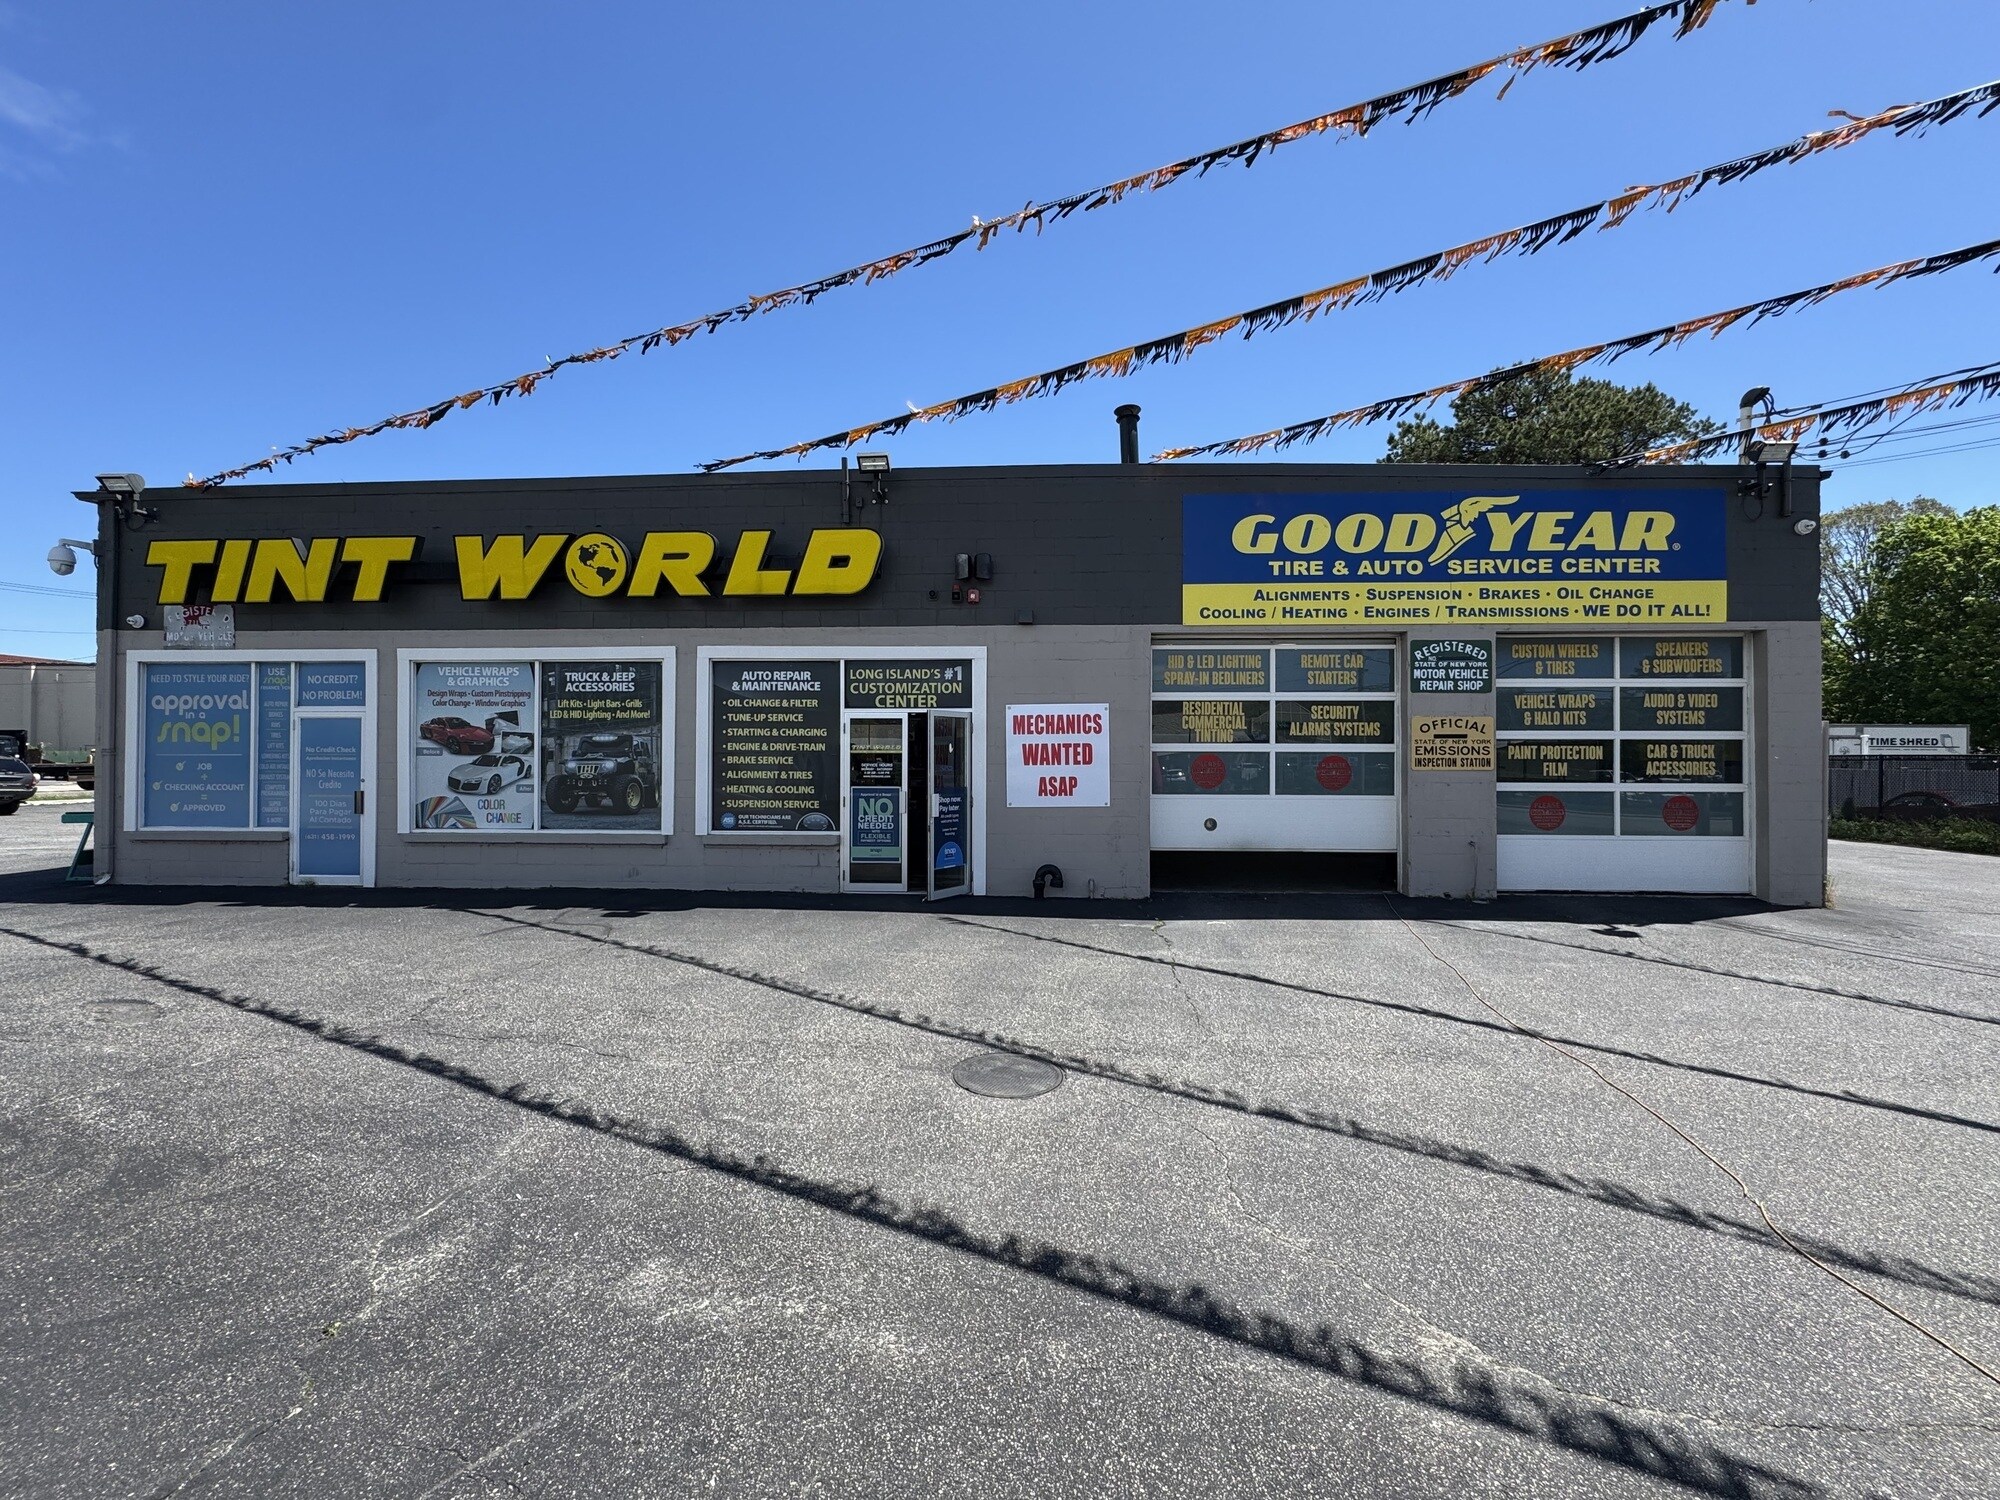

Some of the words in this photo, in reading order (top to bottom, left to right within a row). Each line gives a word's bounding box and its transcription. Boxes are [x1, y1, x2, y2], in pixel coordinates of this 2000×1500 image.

[1232, 513, 1437, 554] GOOD
[1486, 511, 1676, 551] YEAR
[146, 536, 419, 604] TINT
[453, 528, 884, 600] WORLD
[1268, 561, 1324, 575] TIRE
[1332, 560, 1350, 575] &
[1357, 559, 1424, 575] AUTO
[1447, 558, 1553, 574] SERVICE
[1560, 558, 1661, 573] CENTER
[1199, 607, 1267, 619] COOLING
[1282, 606, 1348, 619] HEATING
[1364, 606, 1430, 618] ENGINES
[1445, 605, 1570, 617] TRANSMISSIONS
[1583, 605, 1610, 617] WE
[1616, 605, 1642, 617] DO
[1648, 605, 1666, 617] IT
[1671, 604, 1711, 617] ALL!
[1414, 641, 1488, 660] REGISTERED
[1512, 644, 1554, 658] CUSTOM
[1558, 644, 1599, 658] WHEELS
[1655, 642, 1709, 656] SPEAKERS
[1168, 655, 1184, 669] HID
[1187, 655, 1195, 669] &
[1197, 655, 1214, 669] LED
[1217, 655, 1262, 669] LIGHTING
[1301, 655, 1341, 668] REMOTE
[1343, 655, 1364, 668] CAR
[1535, 661, 1543, 675] &
[1546, 661, 1575, 675] TIRES
[1642, 659, 1650, 673] &
[1653, 659, 1723, 673] SUBWOOFERS
[437, 666, 480, 676] VEHICLE
[482, 666, 519, 676] WRAPS
[565, 672, 600, 682] TRUCK
[601, 672, 610, 682] &
[611, 672, 636, 682] JEEP
[742, 671, 772, 681] AUTO
[773, 671, 812, 681] REPAIR
[850, 669, 883, 679] LONG
[944, 666, 963, 681] #1
[1164, 671, 1210, 685] SPRAY-IN
[1212, 671, 1265, 685] BEDLINERS
[1307, 671, 1357, 685] STARTERS
[1414, 669, 1446, 679] MOTOR
[1448, 669, 1489, 679] VEHICLE
[150, 674, 171, 683] NEED
[173, 674, 182, 683] TO
[184, 674, 205, 683] STYLE
[207, 674, 228, 683] YOUR
[229, 674, 250, 683] RIDE?
[308, 675, 321, 684] NO
[323, 675, 358, 684] CREDIT?
[447, 677, 456, 686] &
[457, 677, 510, 687] GRAPHICS
[565, 682, 635, 692] ACCESSORIES
[732, 682, 741, 691] &
[742, 681, 821, 691] MAINTENANCE
[850, 682, 962, 694] CUSTOMIZATION
[1420, 681, 1454, 691] REPAIR
[1457, 681, 1484, 691] SHOP
[303, 691, 316, 700] NO
[318, 691, 363, 700] PROBLEM!
[427, 690, 447, 699] Design
[448, 690, 467, 699] Wraps
[471, 690, 494, 698] Custom
[874, 694, 938, 708] CENTER
[1514, 694, 1556, 709] VEHICLE
[1558, 693, 1596, 708] WRAPS
[1643, 693, 1675, 708] AUDIO
[1677, 693, 1685, 708] &
[1688, 693, 1718, 708] VIDEO
[151, 690, 249, 715] approval
[557, 700, 569, 708] Lift
[570, 700, 583, 708] Kits
[587, 700, 606, 709] Light
[606, 700, 621, 708] Bars
[625, 699, 643, 708] Grills
[727, 699, 742, 707] OIL
[743, 699, 780, 707] CHANGE
[782, 699, 789, 707] &
[790, 699, 819, 708] FILTER
[1182, 701, 1245, 715] RESIDENTIAL
[549, 710, 562, 719] LED
[570, 710, 582, 719] HID
[583, 710, 611, 720] Lighting
[616, 710, 630, 719] And
[630, 710, 651, 719] More!
[727, 714, 766, 722] TUNE-UP
[767, 714, 804, 722] SERVICE
[1311, 705, 1360, 719] SECURITY
[1524, 711, 1532, 725] &
[1534, 711, 1560, 725] HALO
[1563, 711, 1587, 725] KITS
[1656, 710, 1705, 725] SYSTEMS
[1012, 713, 1103, 735] MECHANICS
[1182, 715, 1247, 729] COMMERCIAL
[1289, 722, 1331, 736] ALARMS
[1333, 722, 1381, 736] SYSTEMS
[1419, 718, 1486, 734] OFFICIAL
[157, 714, 240, 751] snap!
[727, 728, 770, 736] STARTING
[772, 728, 779, 736] &
[780, 728, 828, 737] CHARGING
[1195, 729, 1234, 743] TINTING
[727, 743, 760, 751] ENGINE
[761, 743, 769, 751] &
[770, 743, 826, 752] DRIVE-TRAIN
[1869, 737, 1897, 746] TIME
[1900, 737, 1939, 746] SHRED
[1022, 743, 1094, 766] WANTED
[1415, 746, 1491, 756] EMISSIONS
[1508, 745, 1538, 760] PAINT
[1540, 745, 1604, 760] PROTECTION
[1647, 744, 1668, 758] CAR
[1670, 744, 1678, 758] &
[1681, 744, 1715, 758] TRUCK
[727, 756, 756, 764] BRAKE
[757, 756, 794, 765] SERVICE
[1414, 757, 1457, 767] INSPECTION
[1460, 757, 1491, 767] STATION
[726, 771, 779, 779] ALIGNMENT
[780, 771, 788, 779] &
[788, 771, 813, 780] TIRES
[1543, 762, 1568, 777] FILM
[1646, 761, 1716, 776] ACCESSORIES
[726, 785, 765, 794] HEATING
[766, 785, 773, 794] &
[774, 785, 815, 794] COOLING
[1038, 776, 1078, 797] ASAP
[477, 799, 506, 810] COLOR
[726, 800, 782, 808] SUSPENSION
[783, 800, 820, 809] SERVICE
[858, 798, 894, 816] NO
[486, 812, 522, 824] CHANGE
[858, 815, 894, 823] CREDIT
[858, 822, 894, 830] NEEDED
